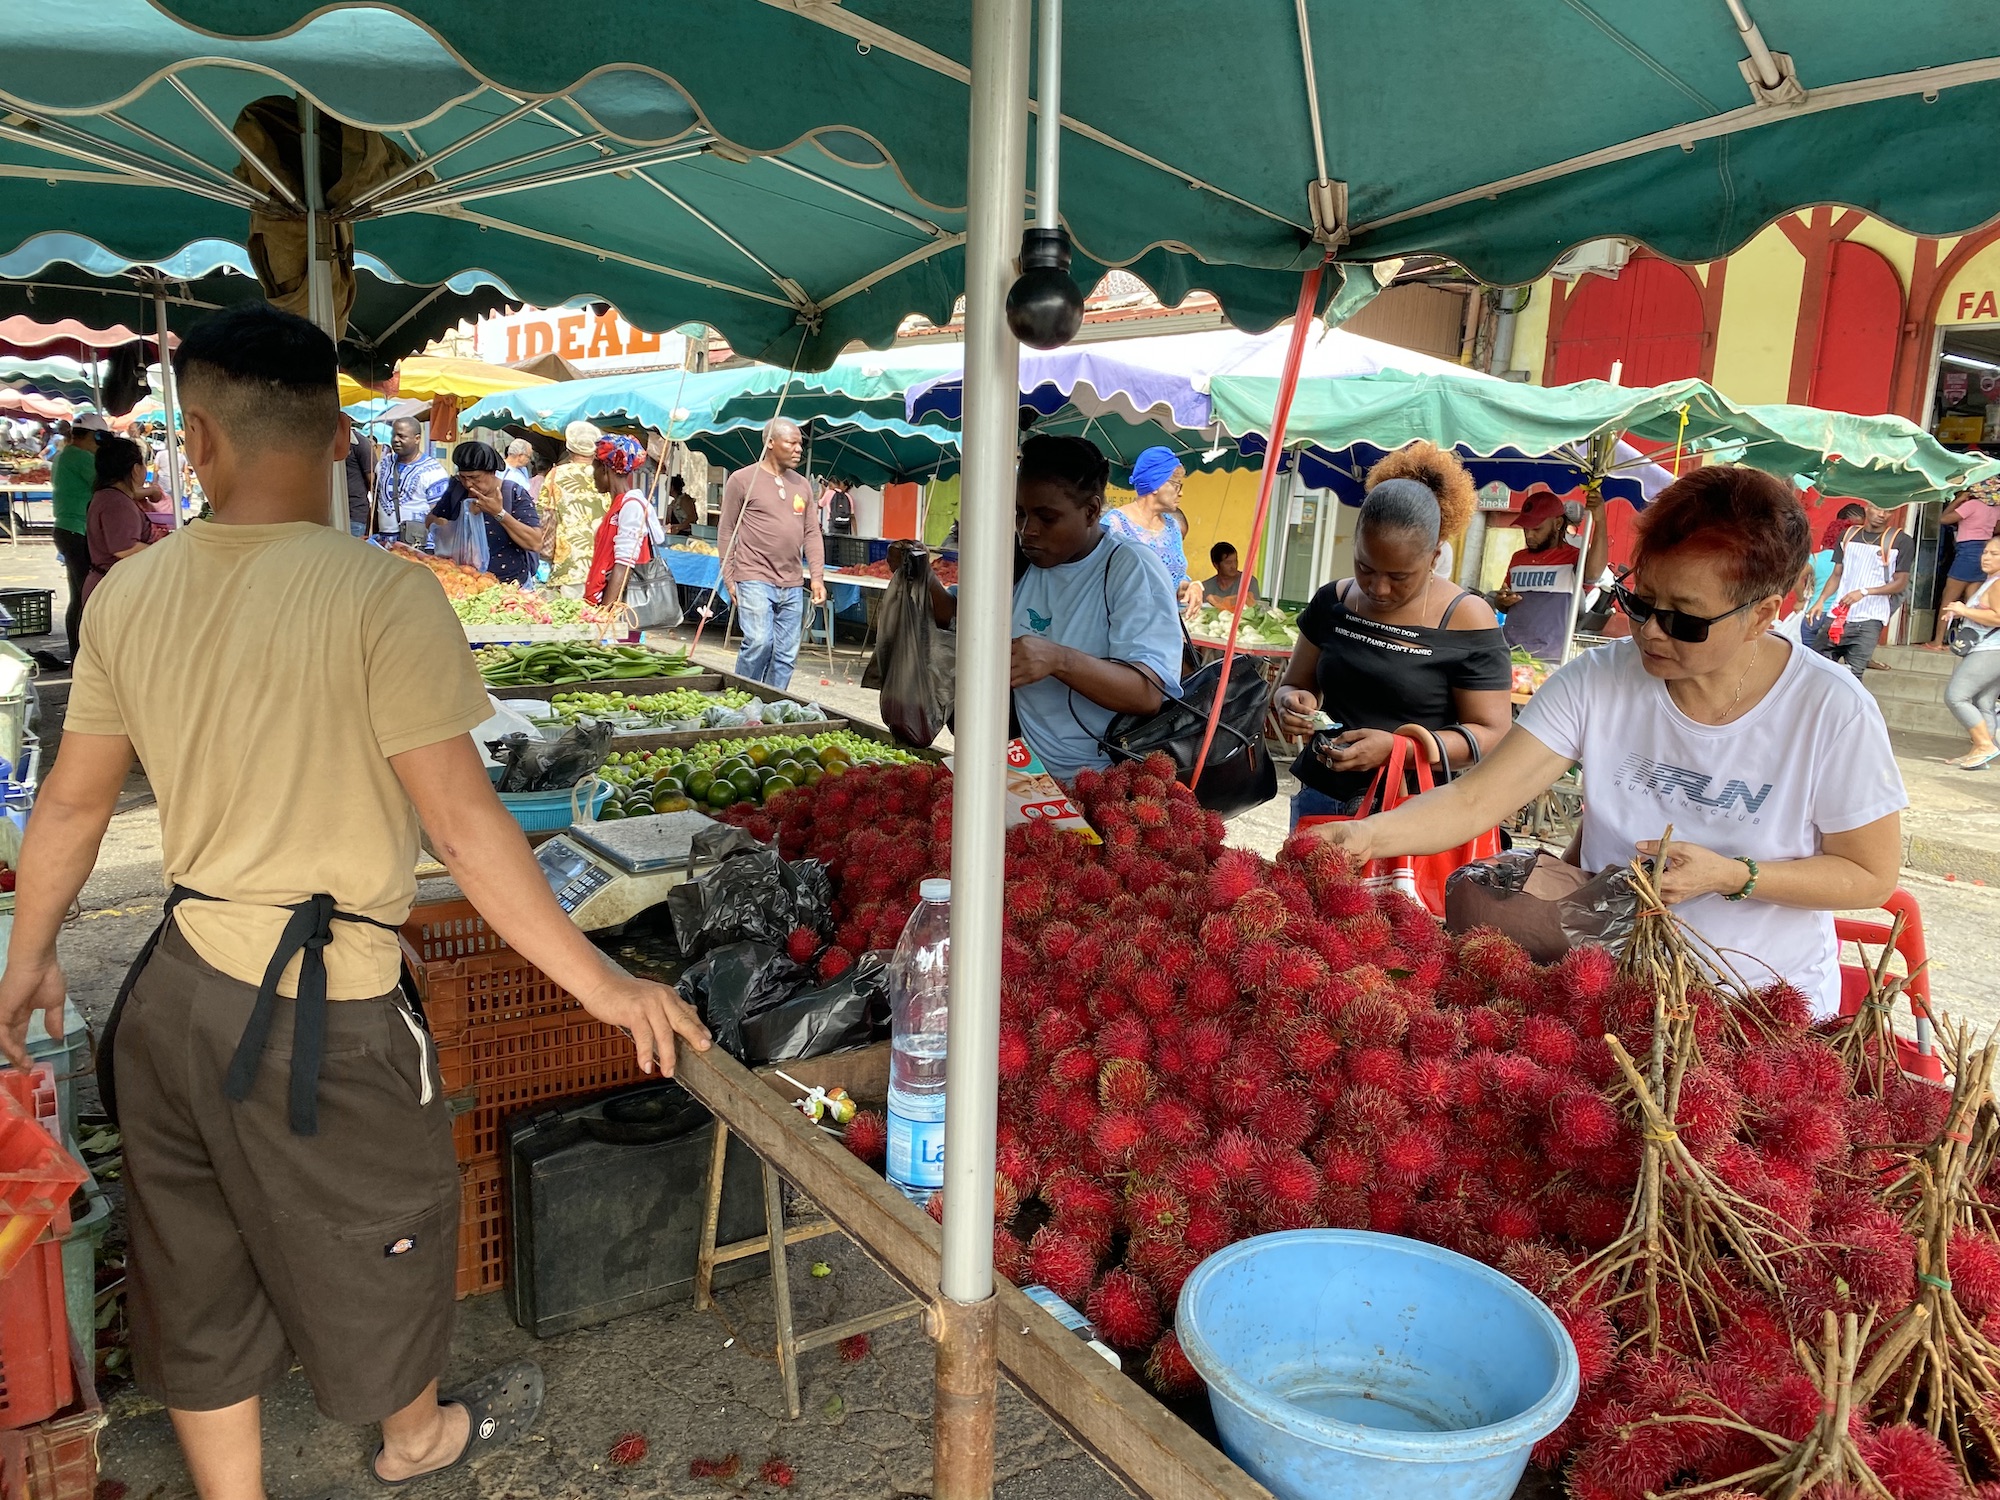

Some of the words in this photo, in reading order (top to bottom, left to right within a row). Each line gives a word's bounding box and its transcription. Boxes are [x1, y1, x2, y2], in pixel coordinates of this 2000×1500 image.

[1956, 290, 1999, 320] FA
[505, 308, 661, 363] IDEAL
[1345, 614, 1362, 623] PANIC
[1381, 624, 1401, 635] PANIC
[1334, 626, 1350, 637] PANIC
[1349, 631, 1367, 642] DON'T
[1366, 637, 1387, 648] PANIC
[1386, 643, 1410, 653] DON'T
[1409, 648, 1433, 656] PANIC
[1640, 759, 1774, 814] RUN
